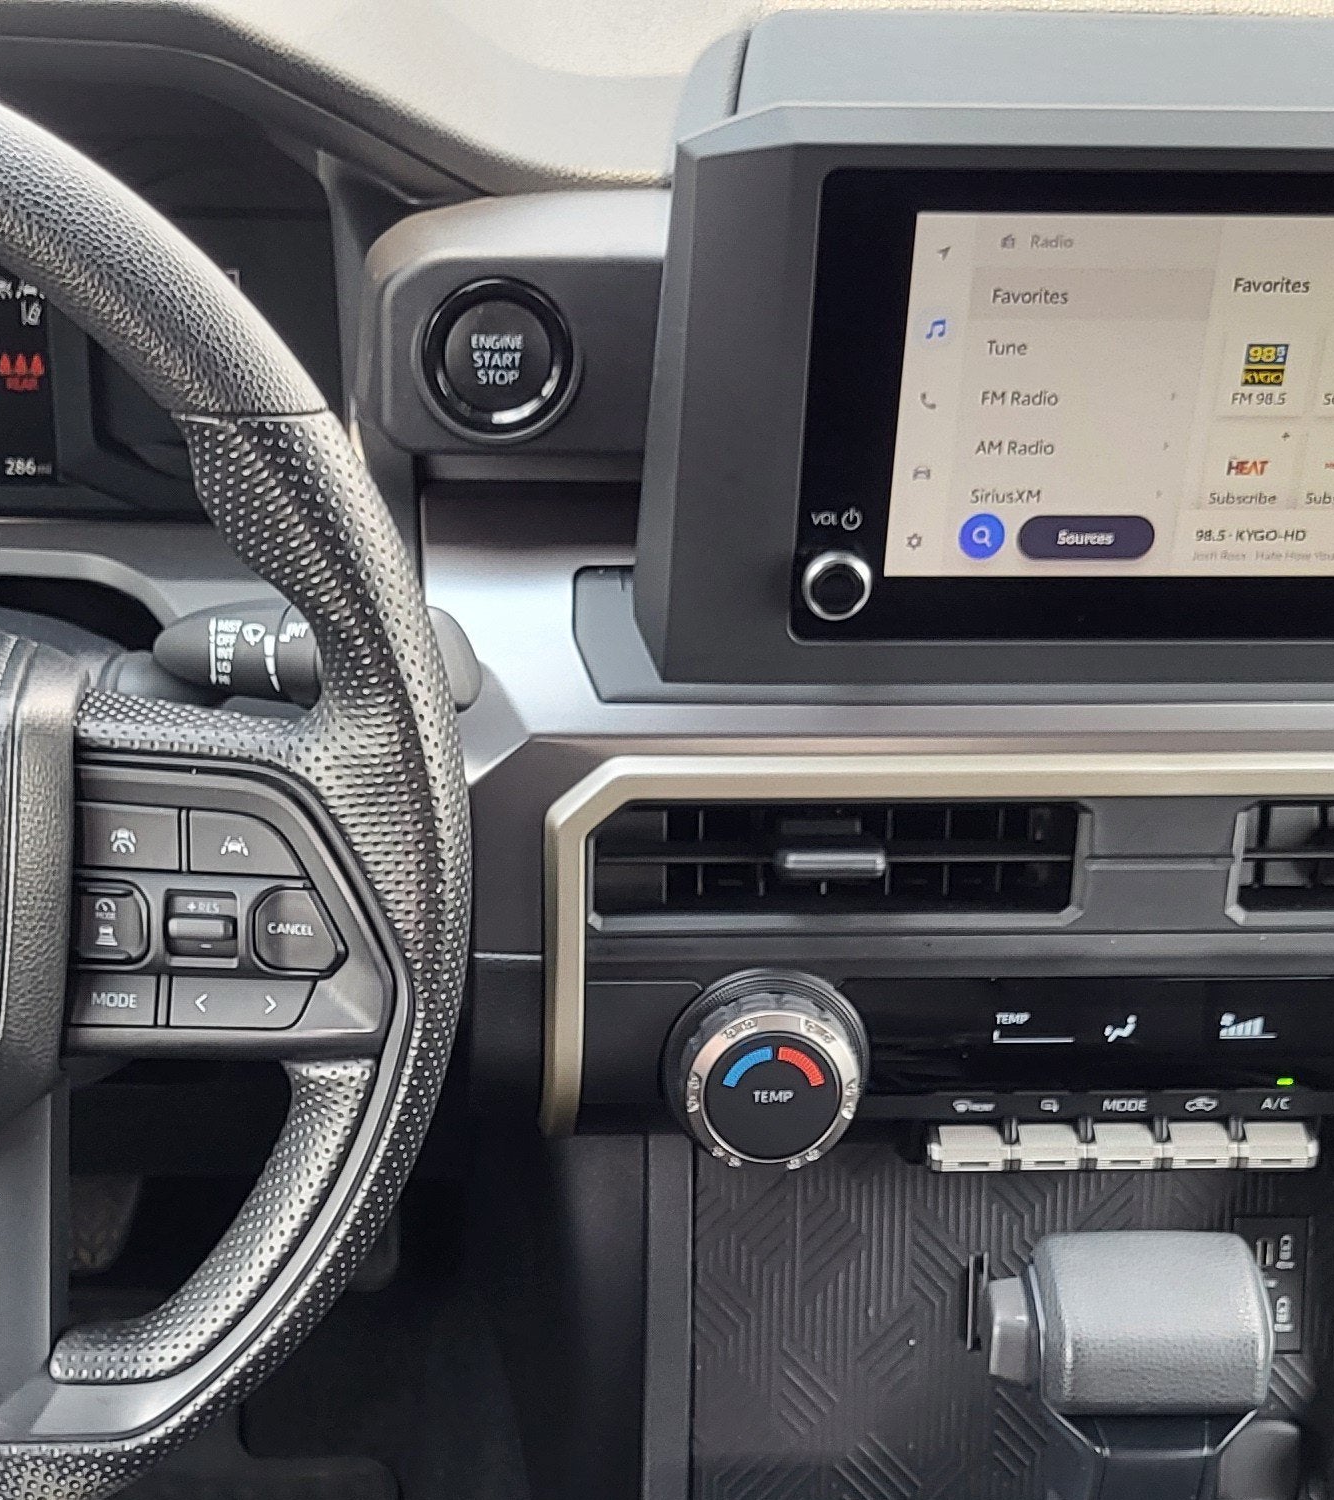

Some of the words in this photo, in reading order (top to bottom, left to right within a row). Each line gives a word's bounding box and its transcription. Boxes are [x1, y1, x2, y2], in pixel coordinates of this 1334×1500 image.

[1030, 234, 1074, 249] Radio
[1233, 277, 1311, 294] Favorites
[992, 287, 1069, 305] Favorites
[471, 333, 523, 350] ENGINE
[987, 340, 1028, 355] Tune
[472, 352, 522, 368] START
[477, 369, 519, 385] STOP
[981, 391, 1006, 406] FM
[1010, 390, 1059, 406] Radio
[1231, 392, 1253, 406] FM
[1255, 392, 1287, 406] 98.5
[975, 440, 1002, 455] AM
[1007, 439, 1055, 456] Radio
[5, 457, 36, 476] 286
[1226, 460, 1269, 476] HEAT
[970, 488, 1041, 504] SiriusXM
[1207, 491, 1277, 506] Subscribe
[811, 512, 838, 526] VOL
[1057, 529, 1115, 546] Sources
[1195, 529, 1225, 543] 98.5
[216, 633, 238, 647] OFF
[216, 647, 234, 660] INT
[267, 922, 314, 937] CANCEL
[92, 992, 137, 1009] MODE
[995, 1011, 1031, 1025] TEMP
[753, 1090, 794, 1103] TEMP
[1261, 1097, 1291, 1111] A/C
[1103, 1098, 1148, 1112] MODE
